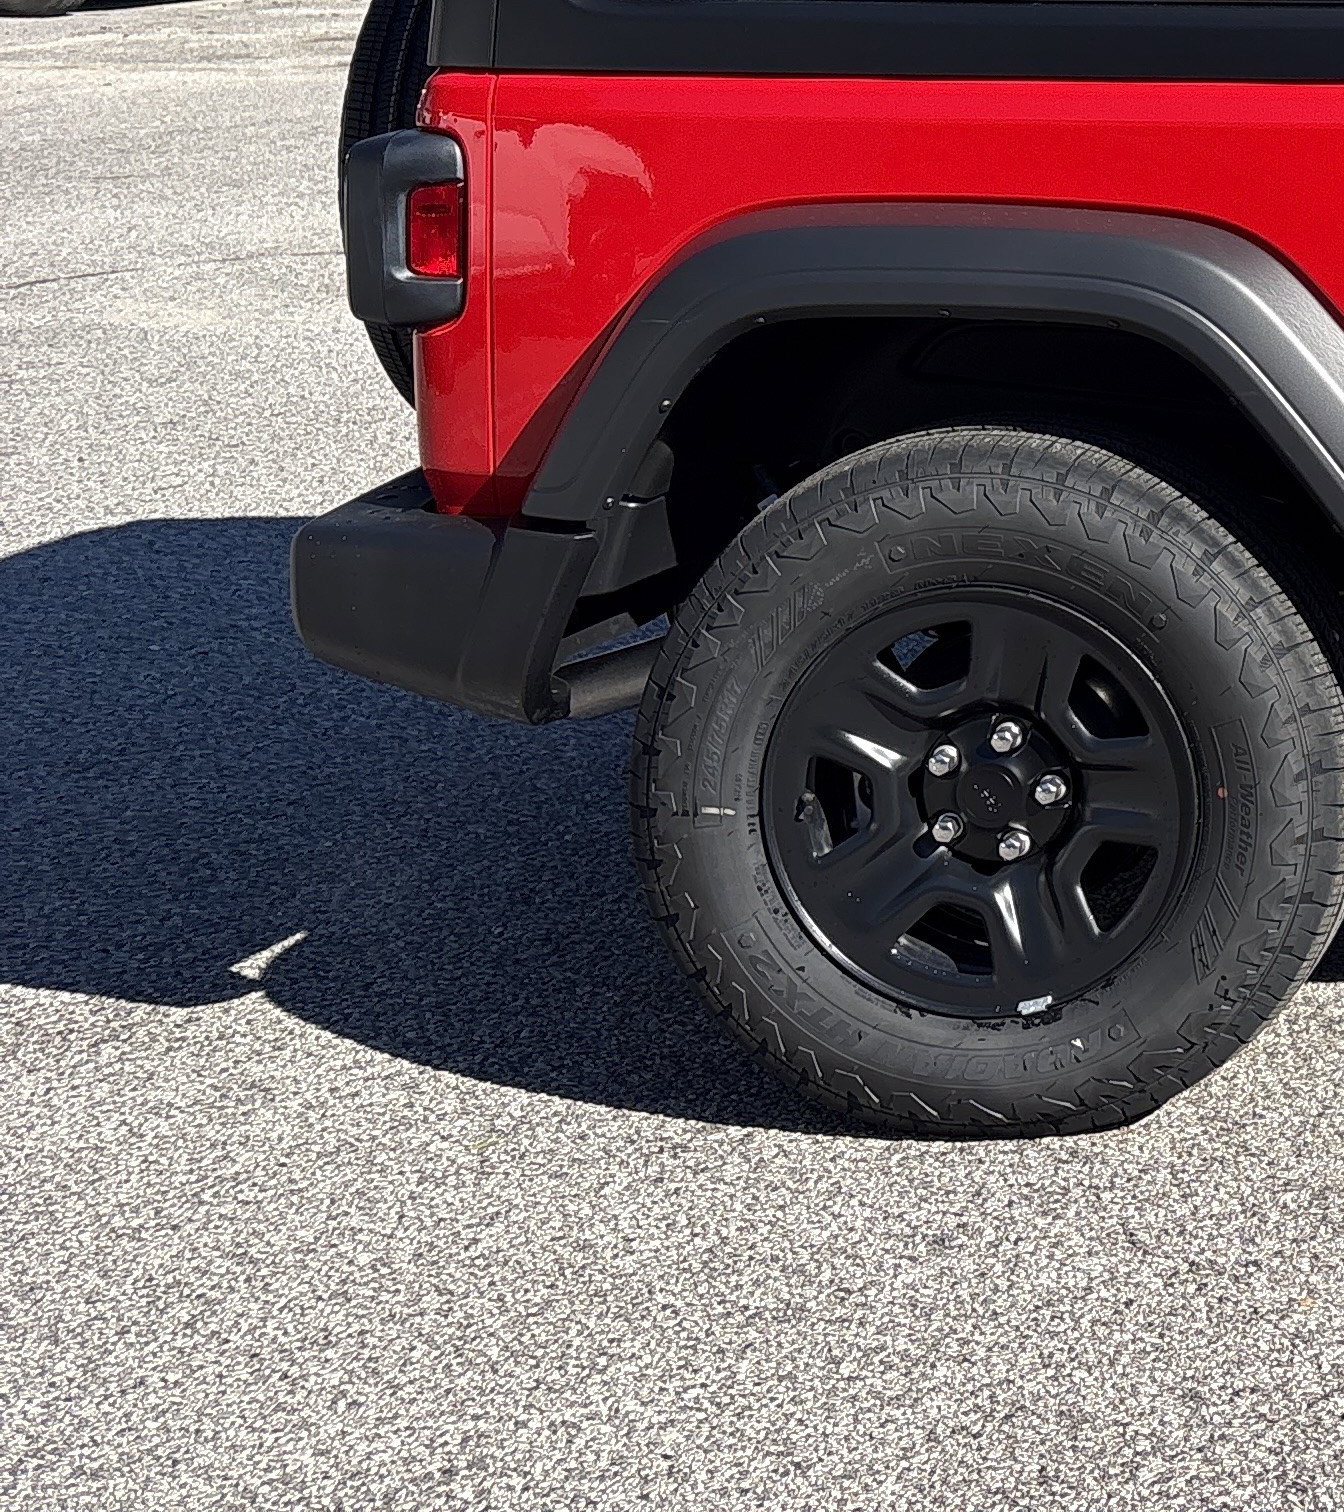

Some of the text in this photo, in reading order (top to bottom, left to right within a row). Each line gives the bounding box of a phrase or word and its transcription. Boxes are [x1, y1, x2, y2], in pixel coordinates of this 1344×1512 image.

[911, 534, 1153, 619] NEXEN
[701, 675, 744, 795] 245/75R17
[1231, 743, 1256, 877] All-Weather
